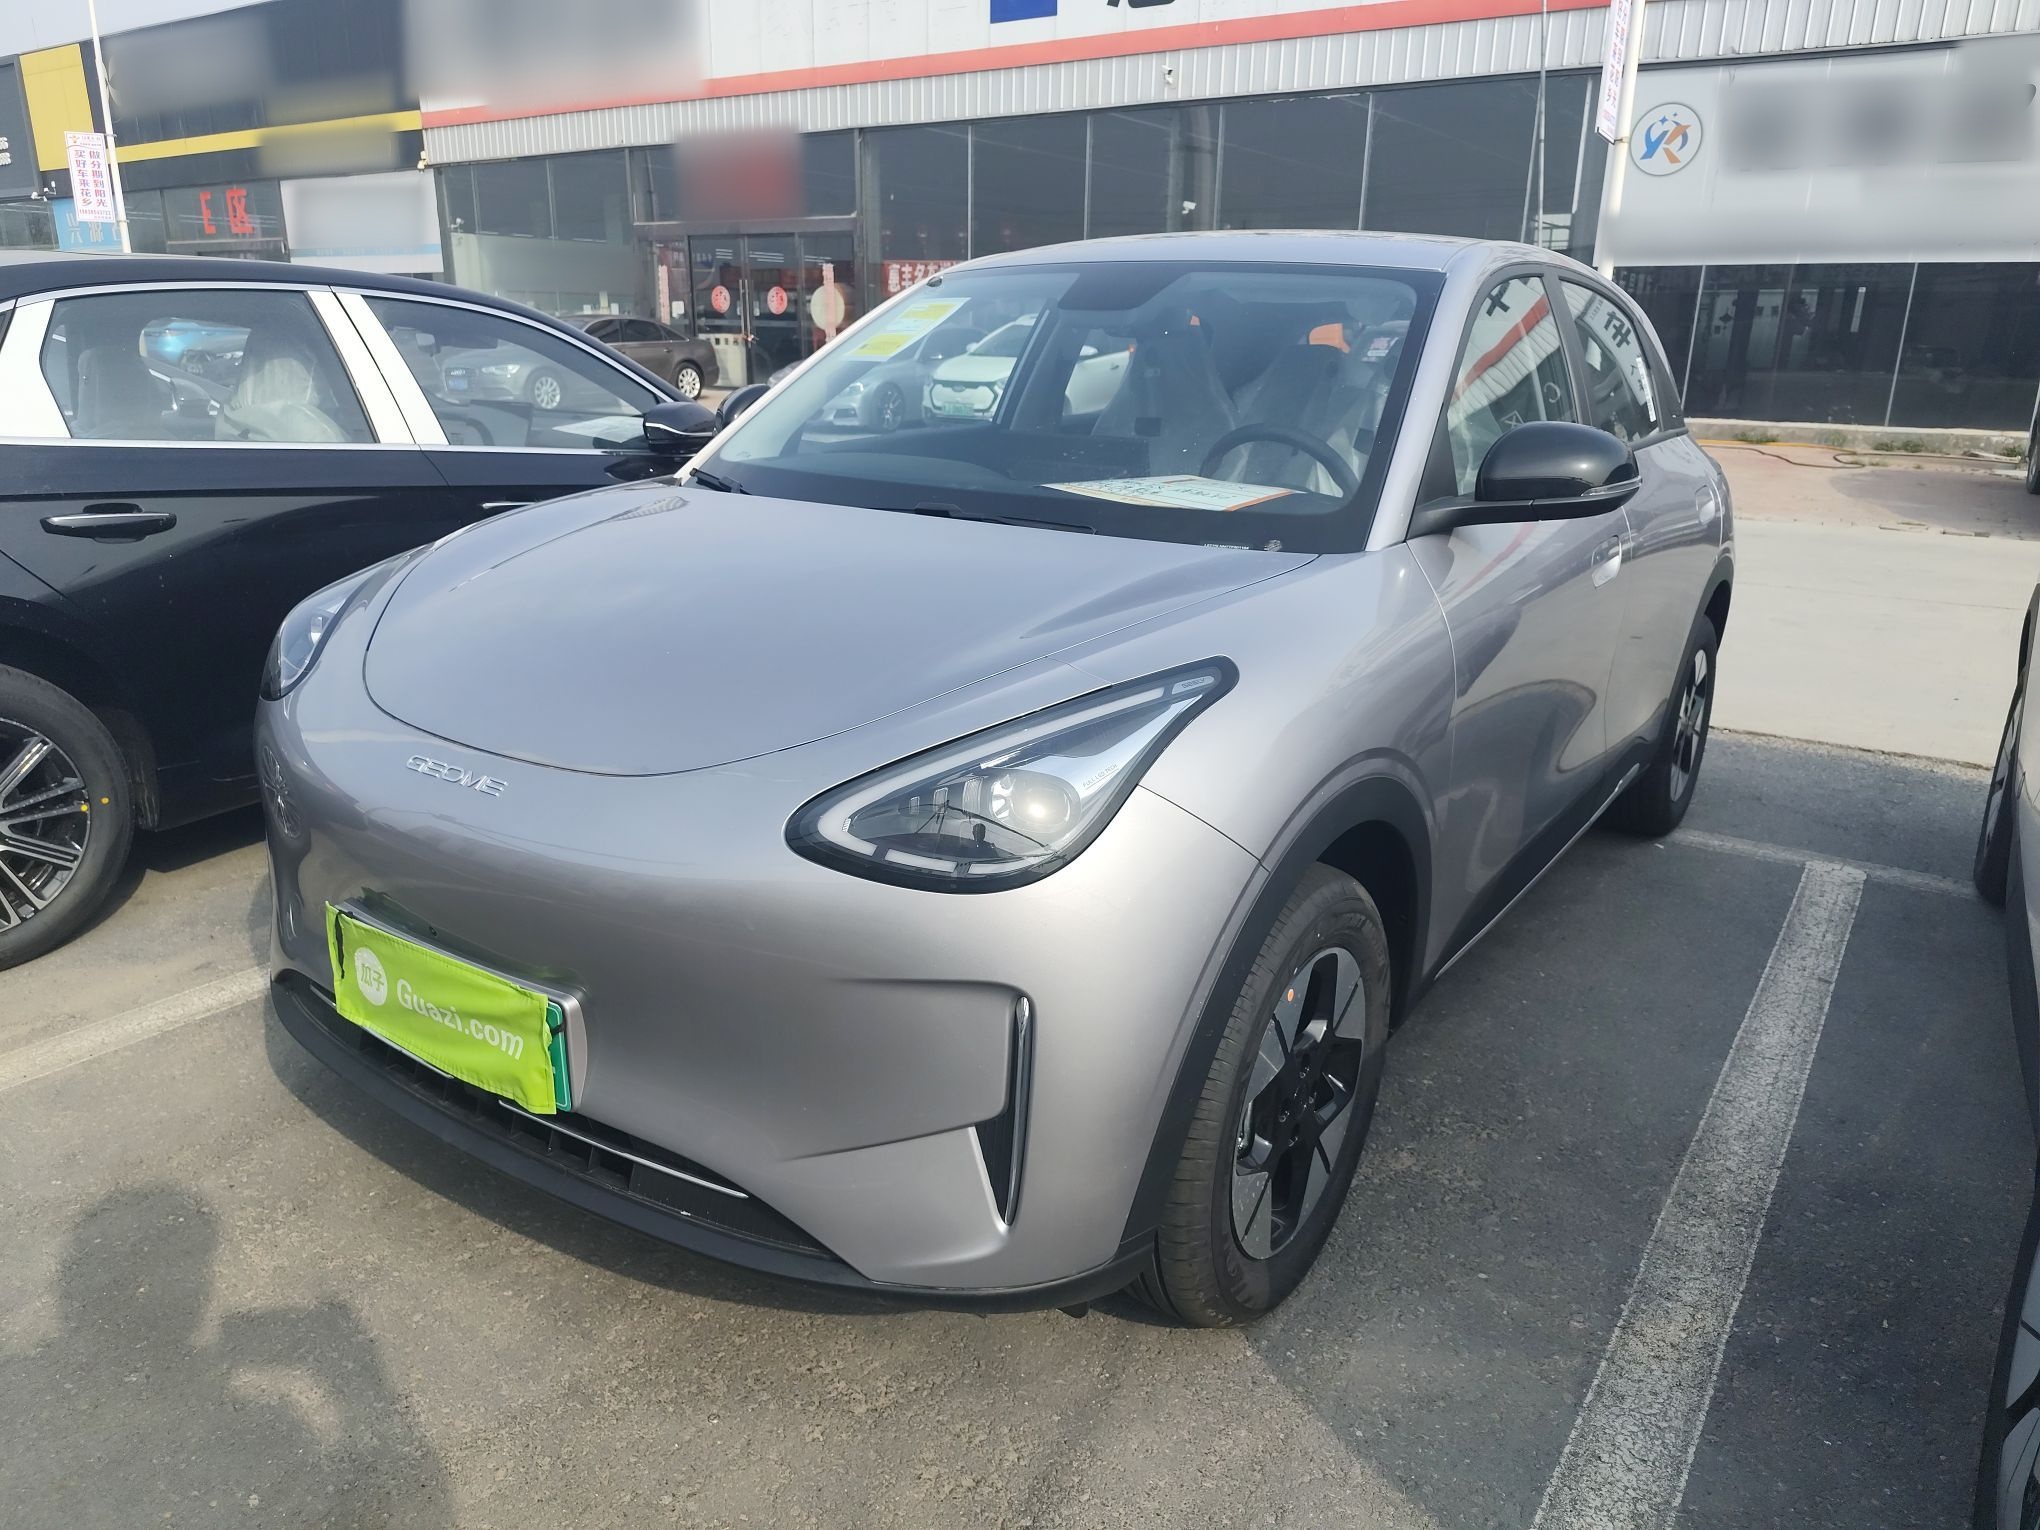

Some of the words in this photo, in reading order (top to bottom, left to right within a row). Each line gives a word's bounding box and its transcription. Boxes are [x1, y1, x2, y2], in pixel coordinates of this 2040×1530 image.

[406, 755, 508, 797] GEOME
[361, 963, 385, 991] 瓜子
[396, 978, 524, 1061] Guazi.com
